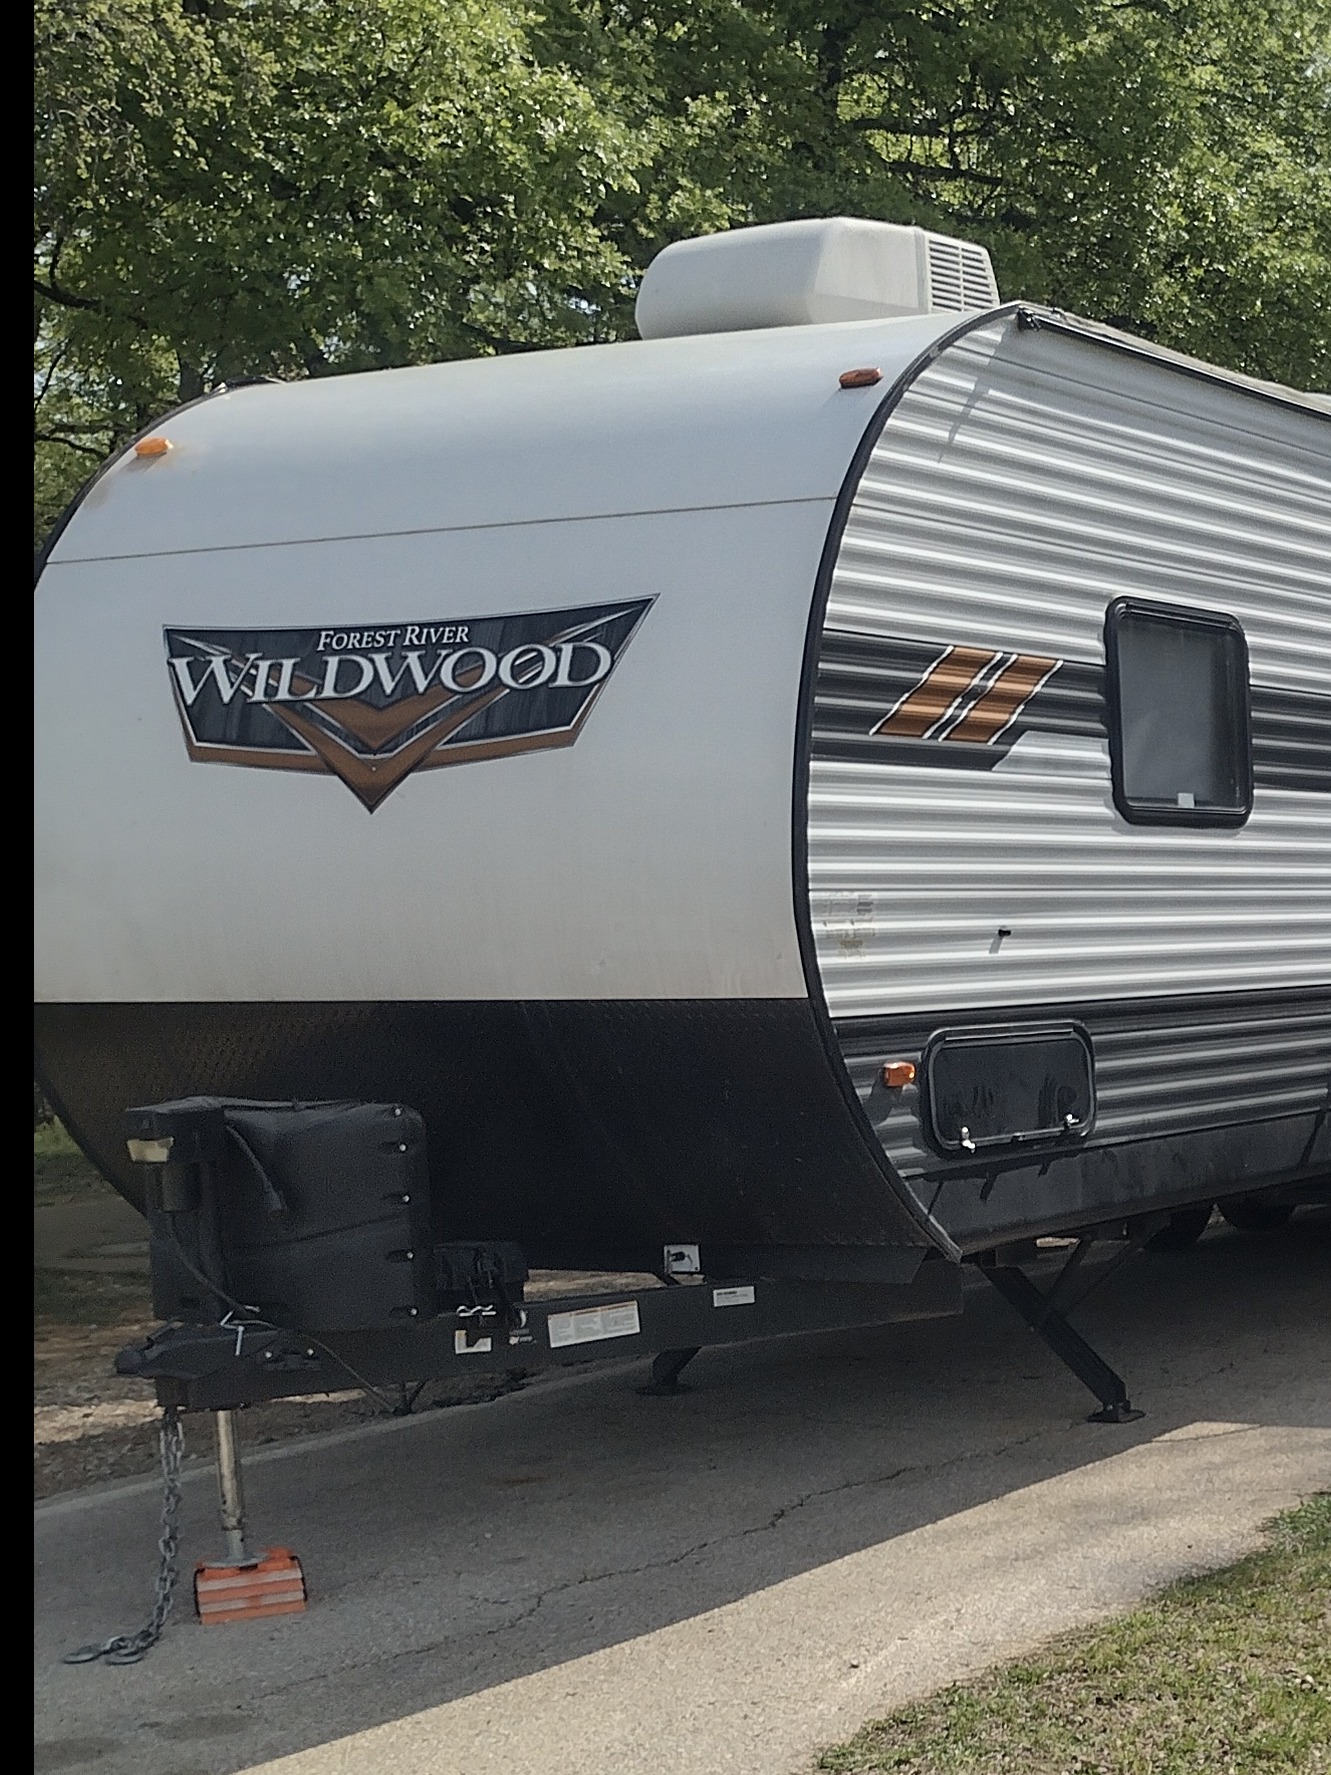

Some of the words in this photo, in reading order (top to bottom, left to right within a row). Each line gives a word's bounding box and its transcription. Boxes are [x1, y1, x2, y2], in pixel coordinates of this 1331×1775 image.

[316, 630, 401, 651] FOREST
[402, 625, 469, 646] RIVER
[168, 641, 614, 706] WILDWOOD
